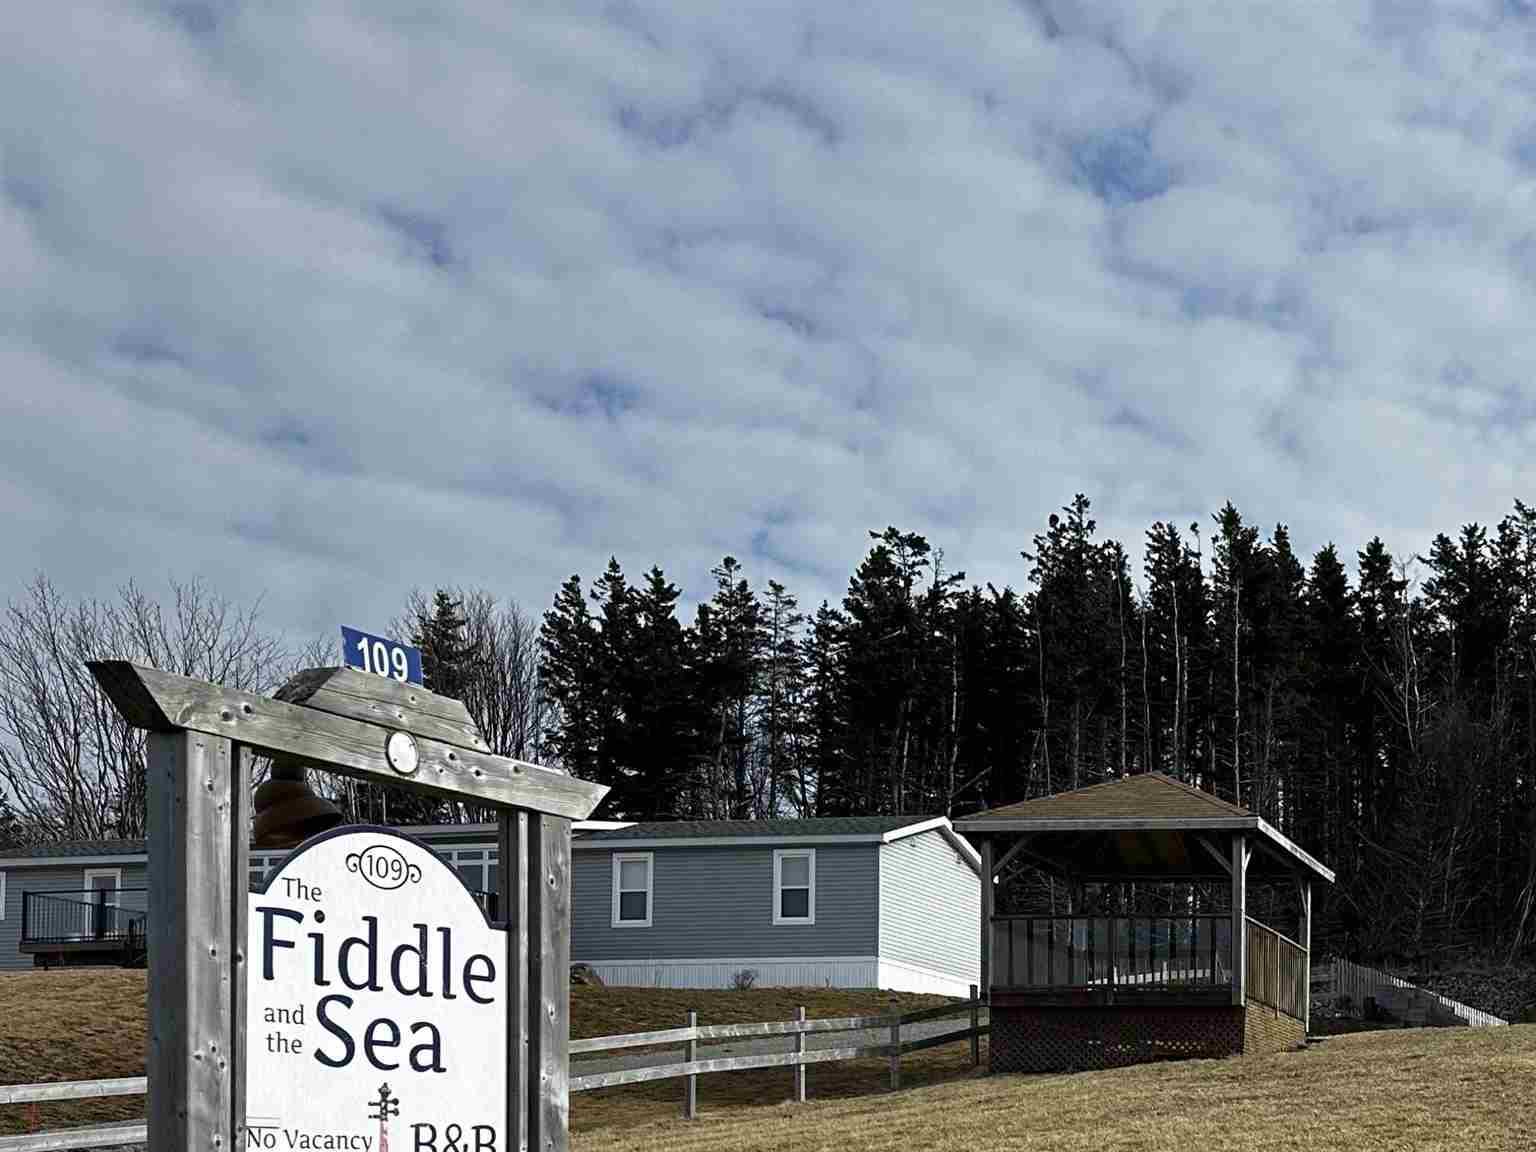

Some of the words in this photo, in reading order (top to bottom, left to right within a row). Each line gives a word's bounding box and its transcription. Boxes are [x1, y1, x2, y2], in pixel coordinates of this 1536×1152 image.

[357, 637, 408, 682] 109
[366, 854, 402, 881] 109
[282, 877, 322, 902] The
[255, 906, 496, 1004] Fiddle
[264, 1004, 305, 1025] and
[266, 1032, 303, 1054] the
[313, 994, 447, 1073] Sea
[247, 1128, 277, 1150] No
